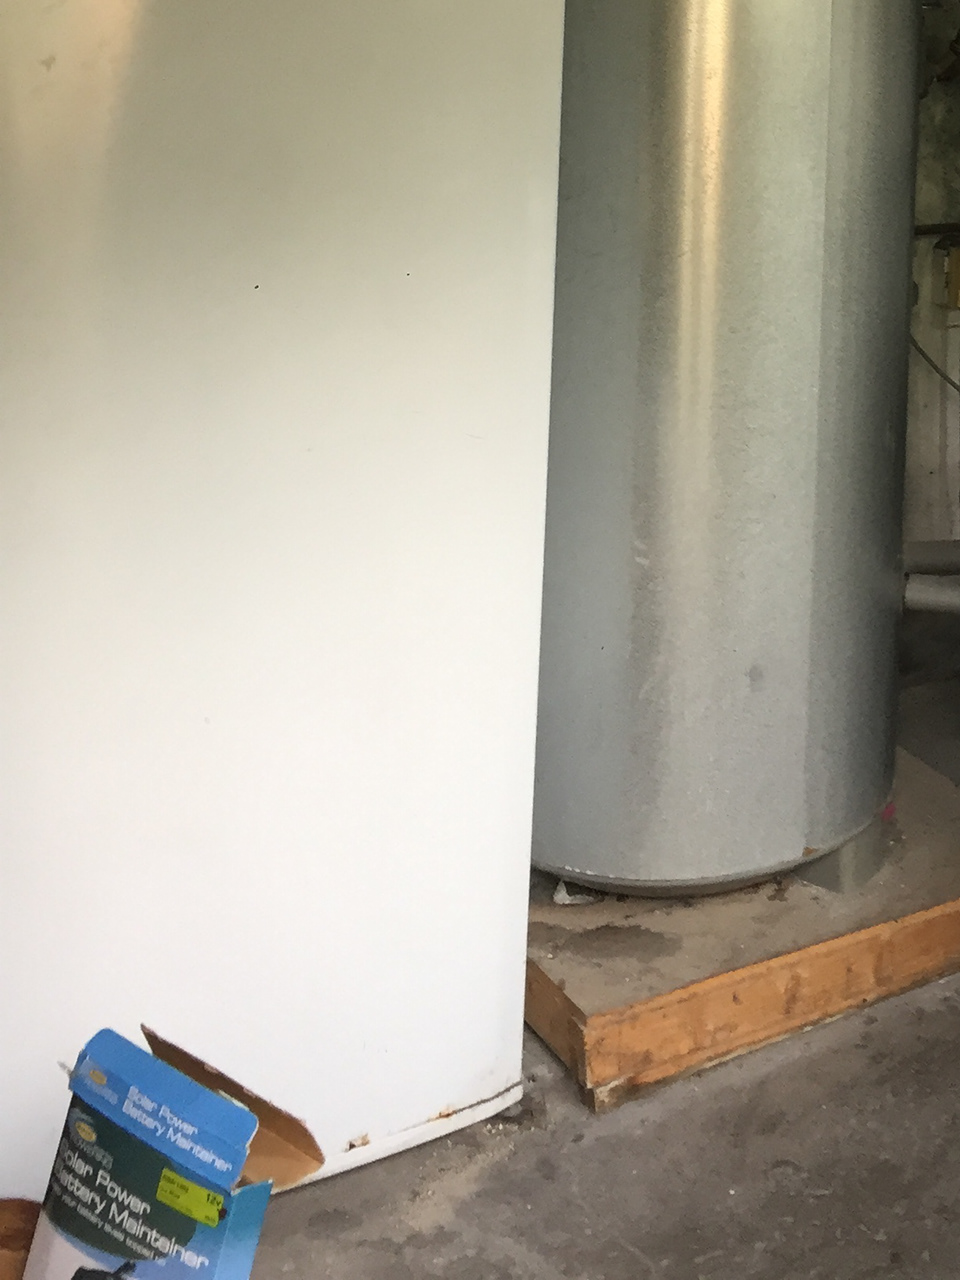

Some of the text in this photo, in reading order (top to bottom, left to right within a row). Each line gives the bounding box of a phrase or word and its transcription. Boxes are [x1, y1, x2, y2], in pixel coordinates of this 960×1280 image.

[122, 1098, 166, 1136] Battery
[166, 1126, 233, 1172] Maintainer
[128, 1085, 158, 1112] Solar
[158, 1105, 199, 1136] Power
[95, 1169, 152, 1216] Power
[108, 1202, 210, 1269] Maintainer
